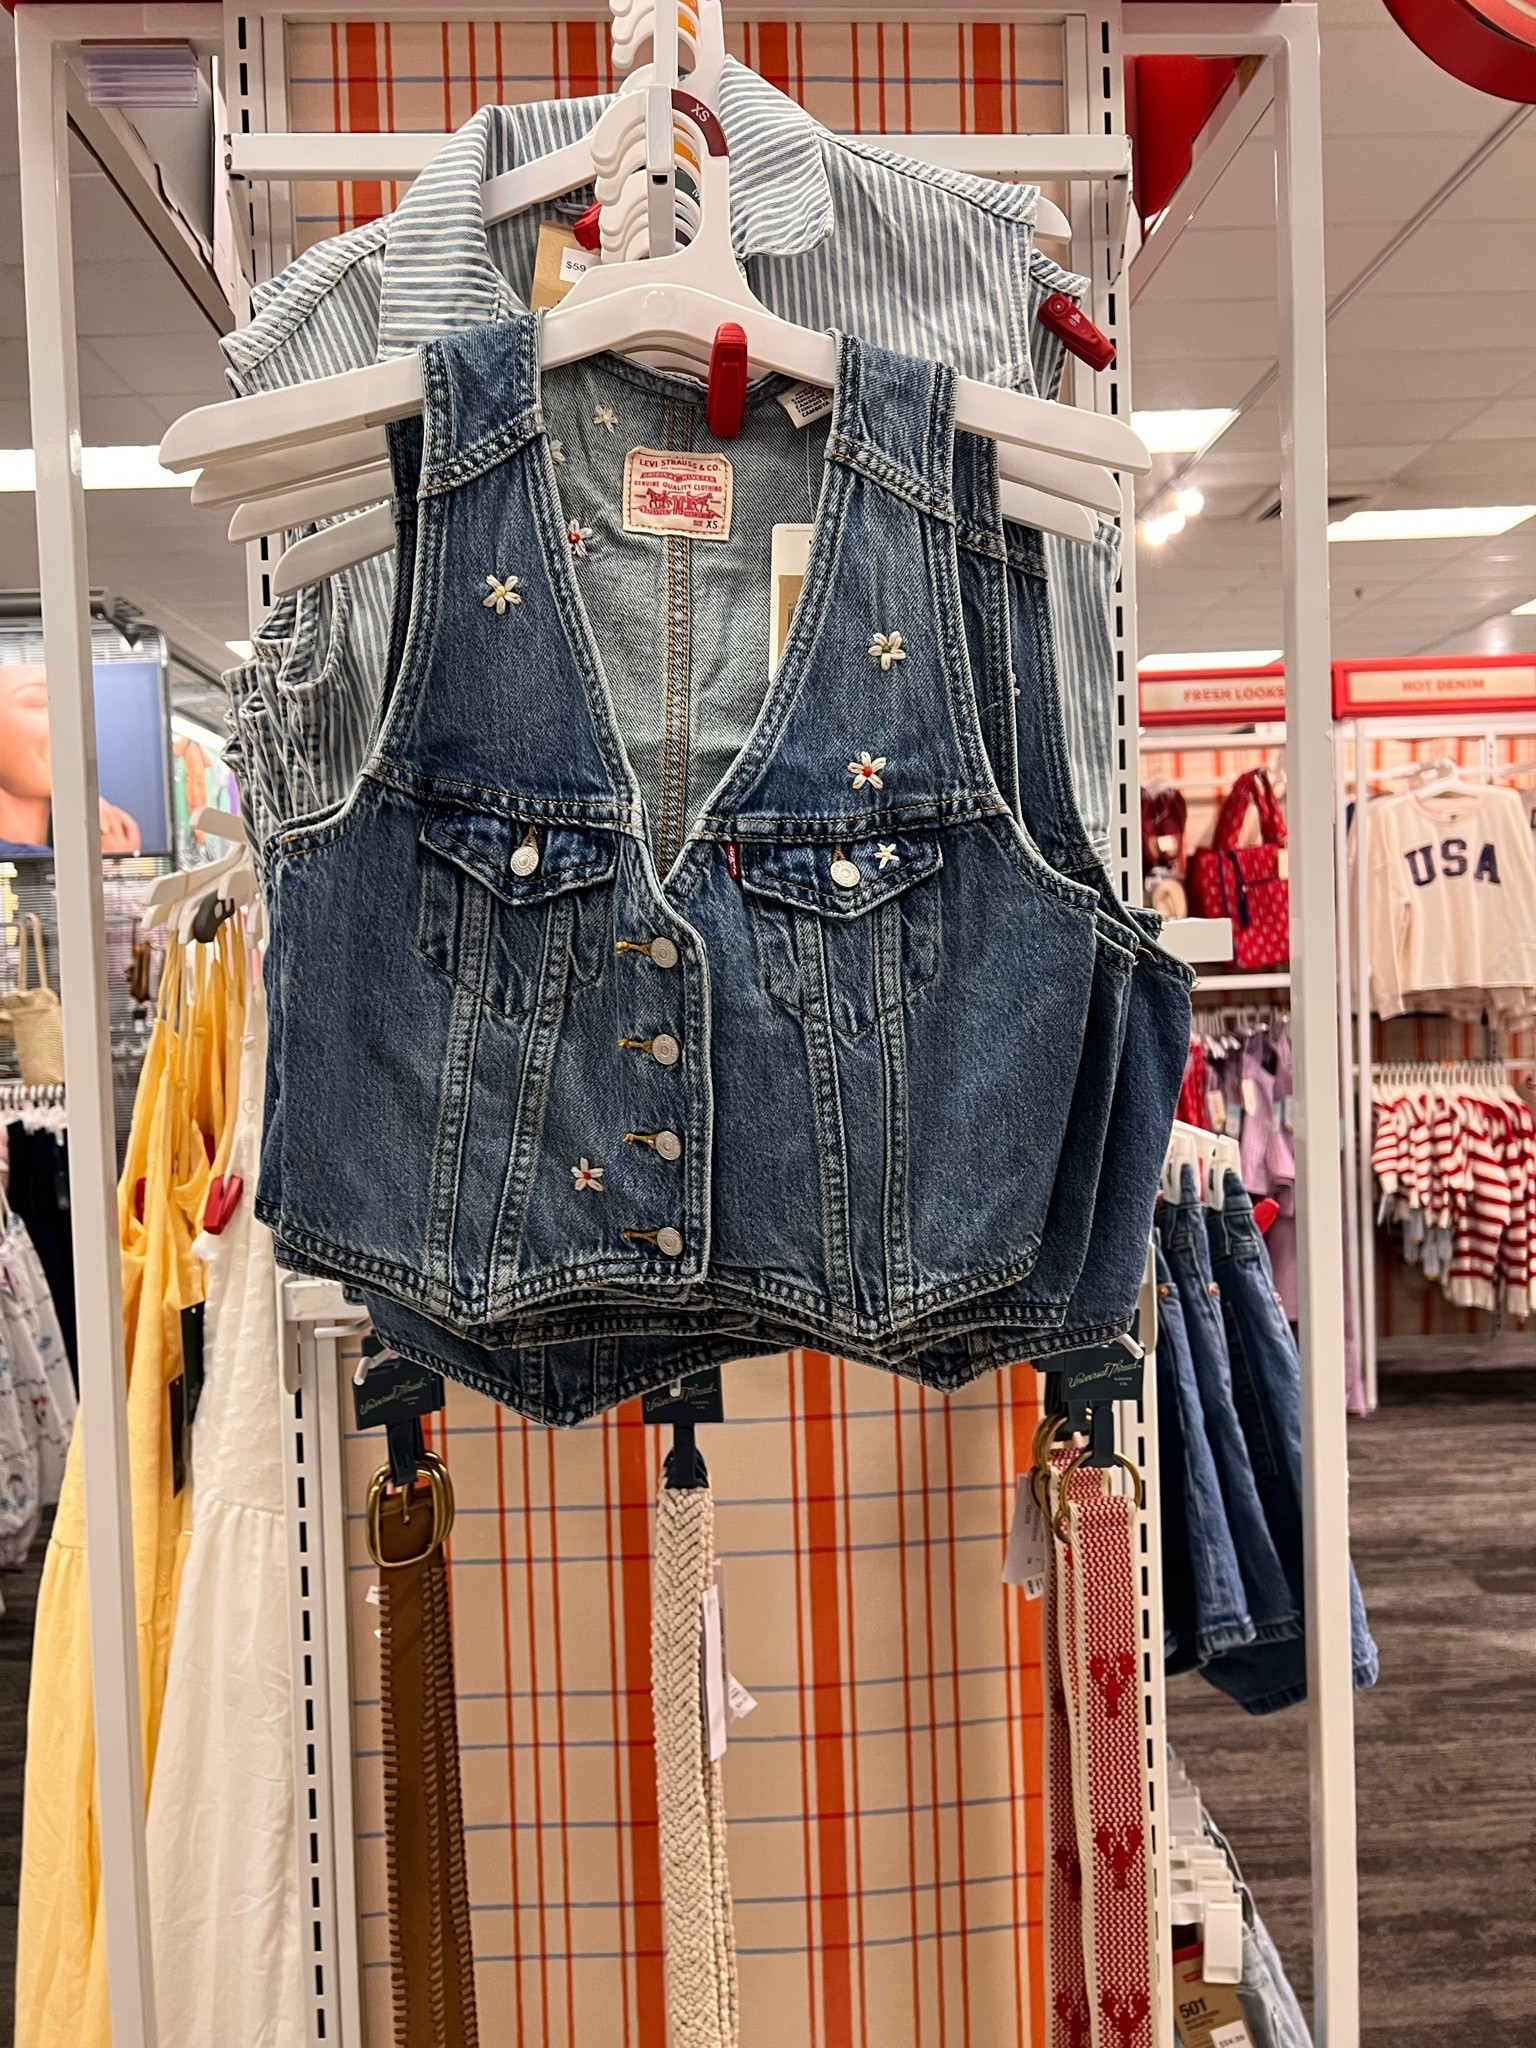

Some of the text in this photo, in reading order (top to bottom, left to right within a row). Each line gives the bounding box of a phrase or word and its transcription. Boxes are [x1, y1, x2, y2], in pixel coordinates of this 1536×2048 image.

[691, 102, 710, 121] XS
[639, 459, 658, 468] LEVI
[661, 459, 698, 470] STRAUSS
[706, 464, 721, 472] CO.
[634, 480, 723, 492] GENUINE QUALITY CLOTHING
[706, 520, 718, 529] XS
[1402, 677, 1486, 693] HOT DENIM
[1183, 687, 1233, 703] FRESH
[1403, 838, 1501, 887] USA
[1179, 1996, 1207, 2019] 501
